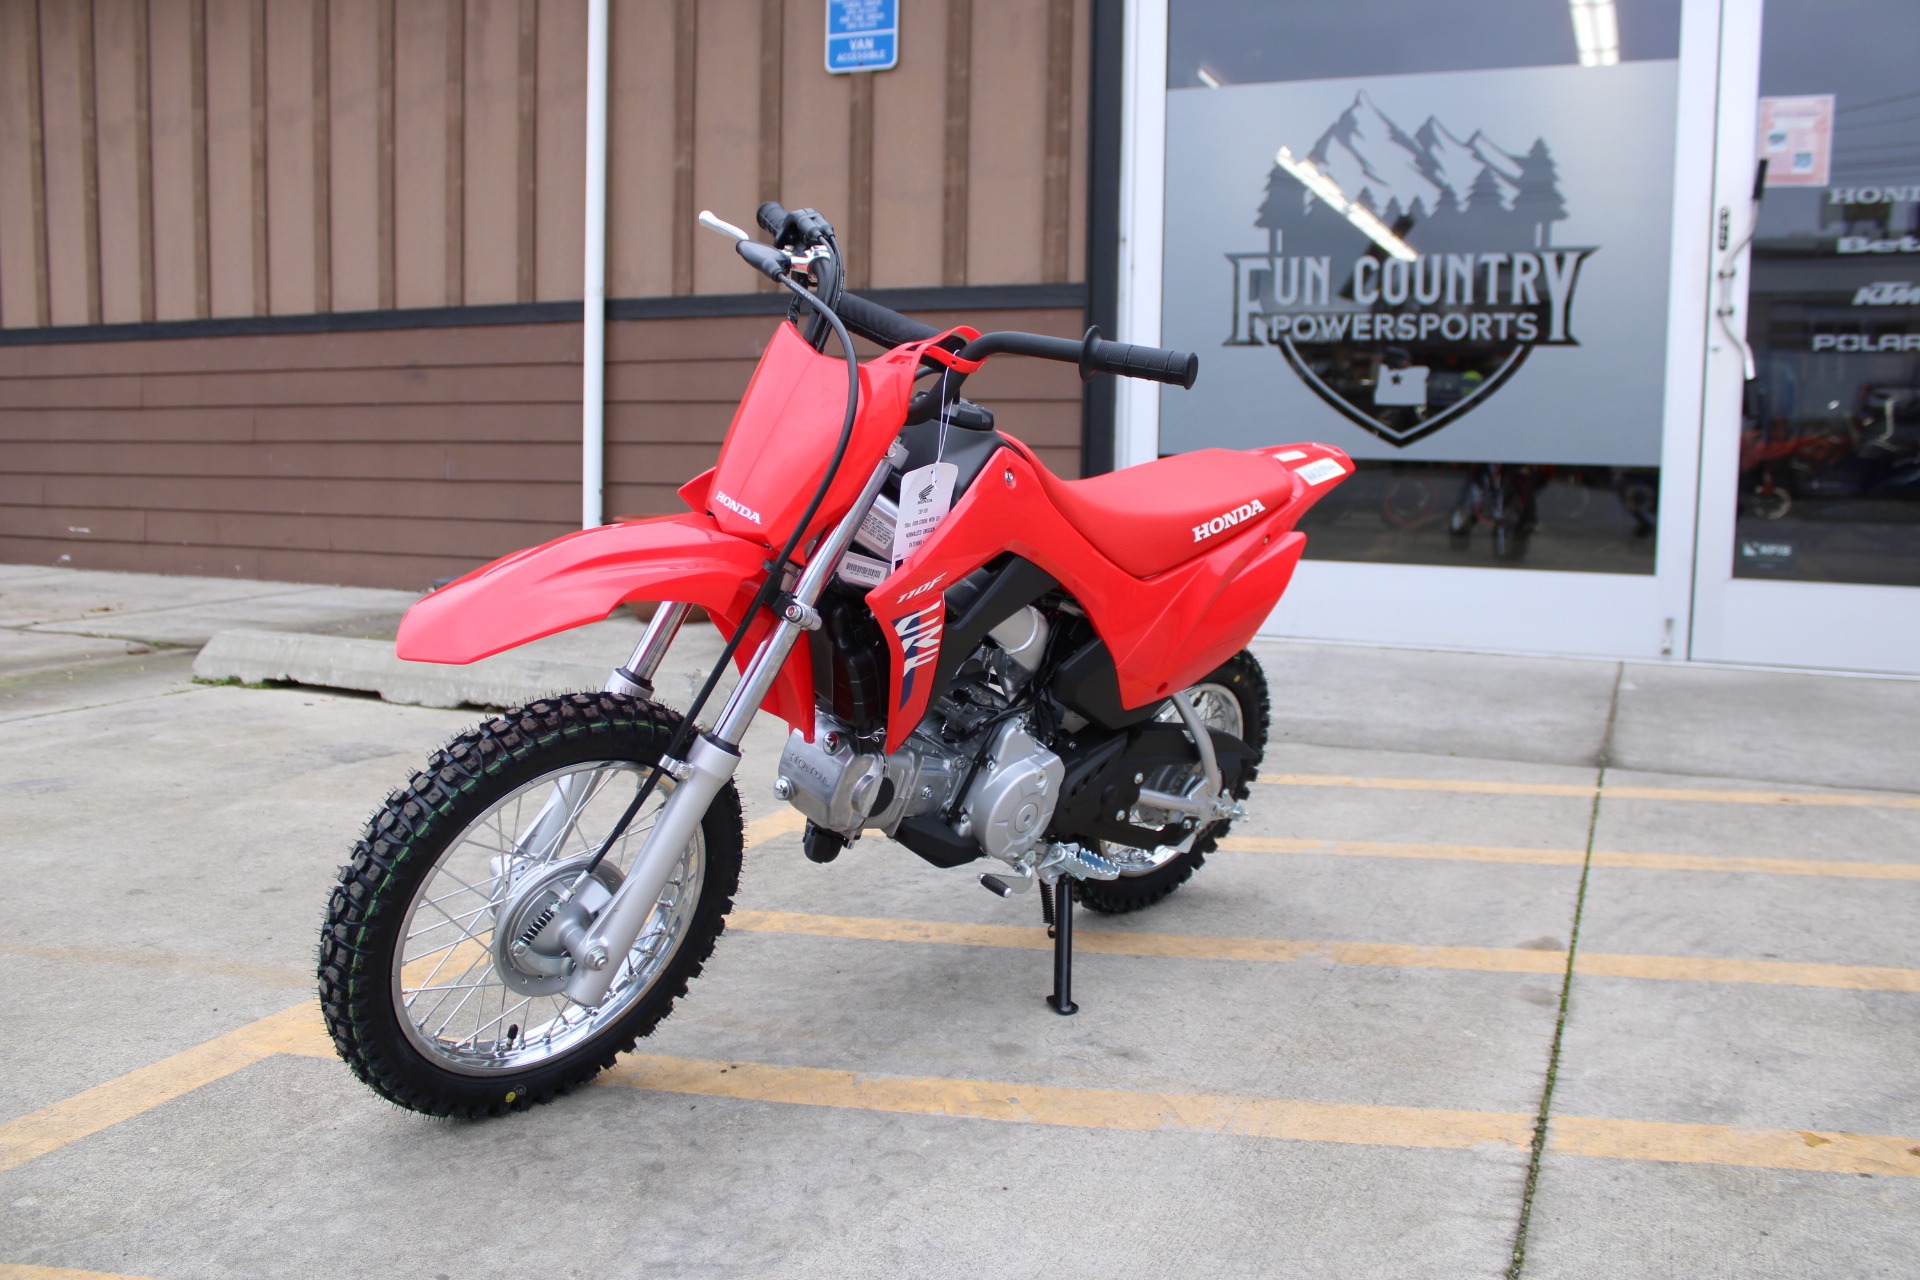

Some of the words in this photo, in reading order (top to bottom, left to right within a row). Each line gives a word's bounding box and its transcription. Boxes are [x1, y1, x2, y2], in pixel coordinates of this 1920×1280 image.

[849, 37, 874, 51] VAN
[1224, 253, 1332, 346] FUN
[1353, 247, 1601, 346] COUNTRY
[1271, 312, 1539, 342] POWERSPORTS
[715, 490, 761, 525] HONDA
[1192, 499, 1266, 543] HONDA
[897, 572, 947, 604] 110F
[894, 600, 943, 678] CRF
